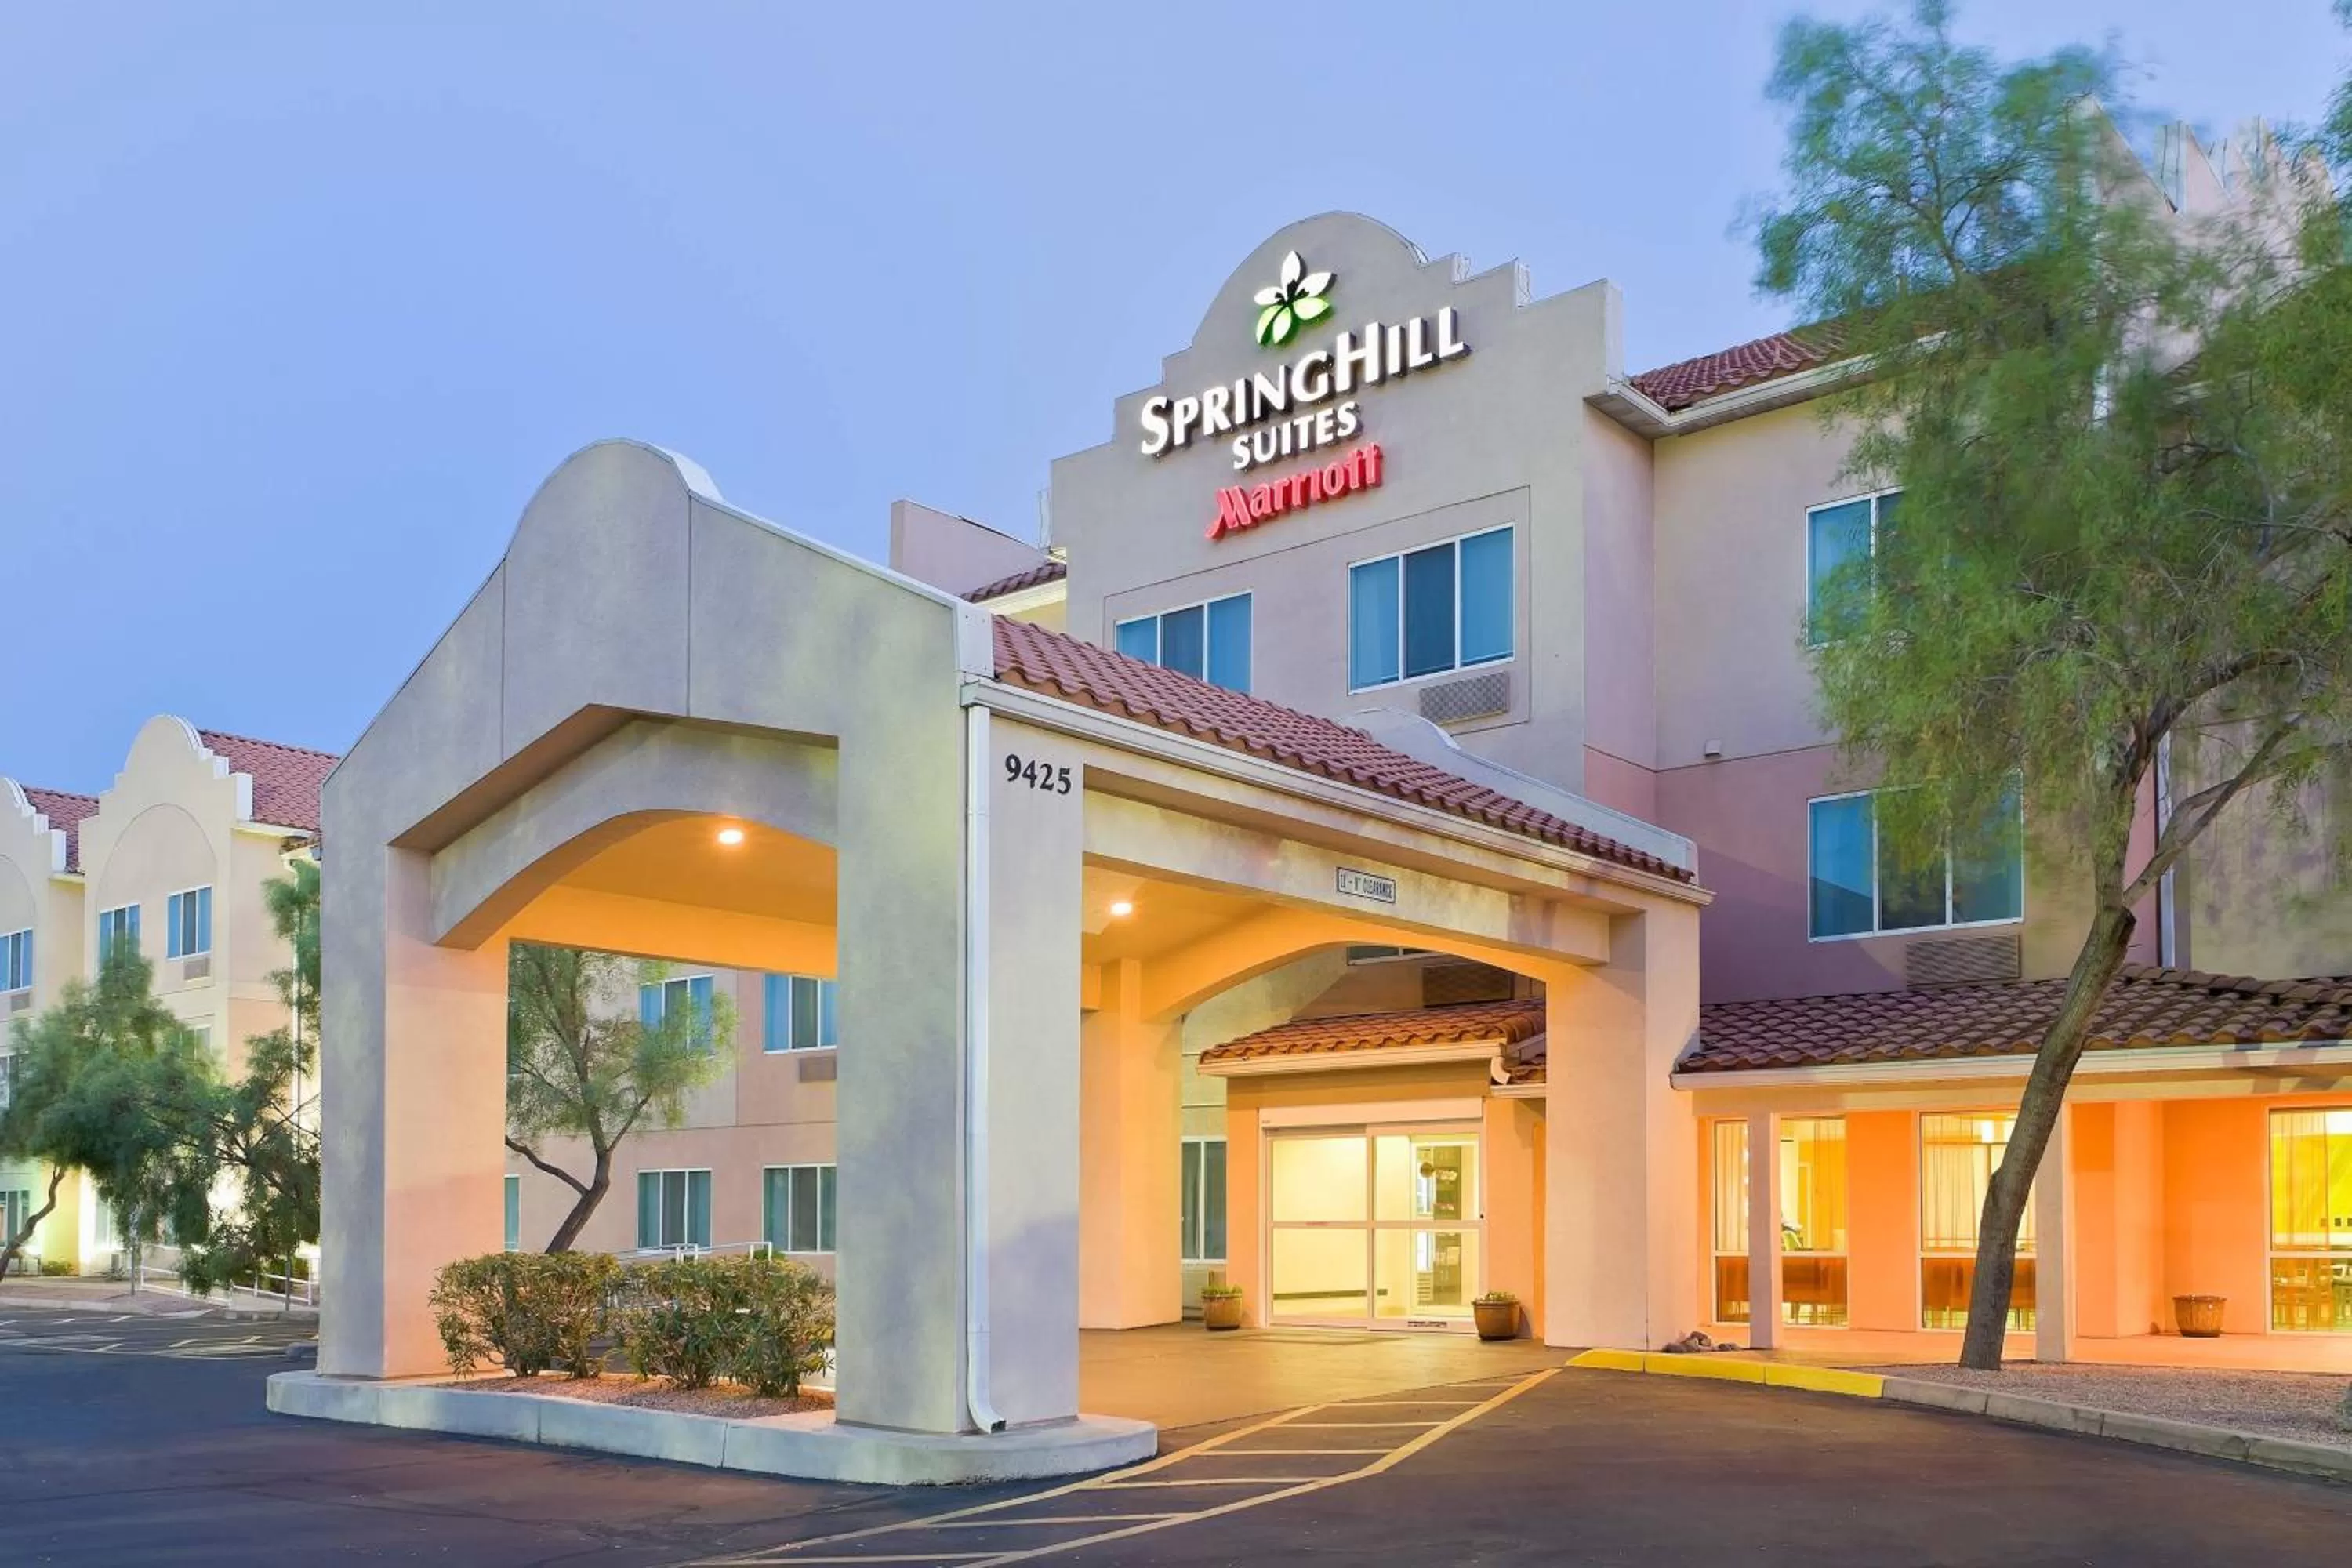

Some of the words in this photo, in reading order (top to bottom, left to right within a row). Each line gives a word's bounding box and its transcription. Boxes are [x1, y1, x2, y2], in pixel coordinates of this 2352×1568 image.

[1141, 307, 1467, 456] SPRINGHILL
[1232, 401, 1359, 470] SUITES
[1205, 441, 1383, 539] Marriott
[1005, 753, 1072, 795] 9425
